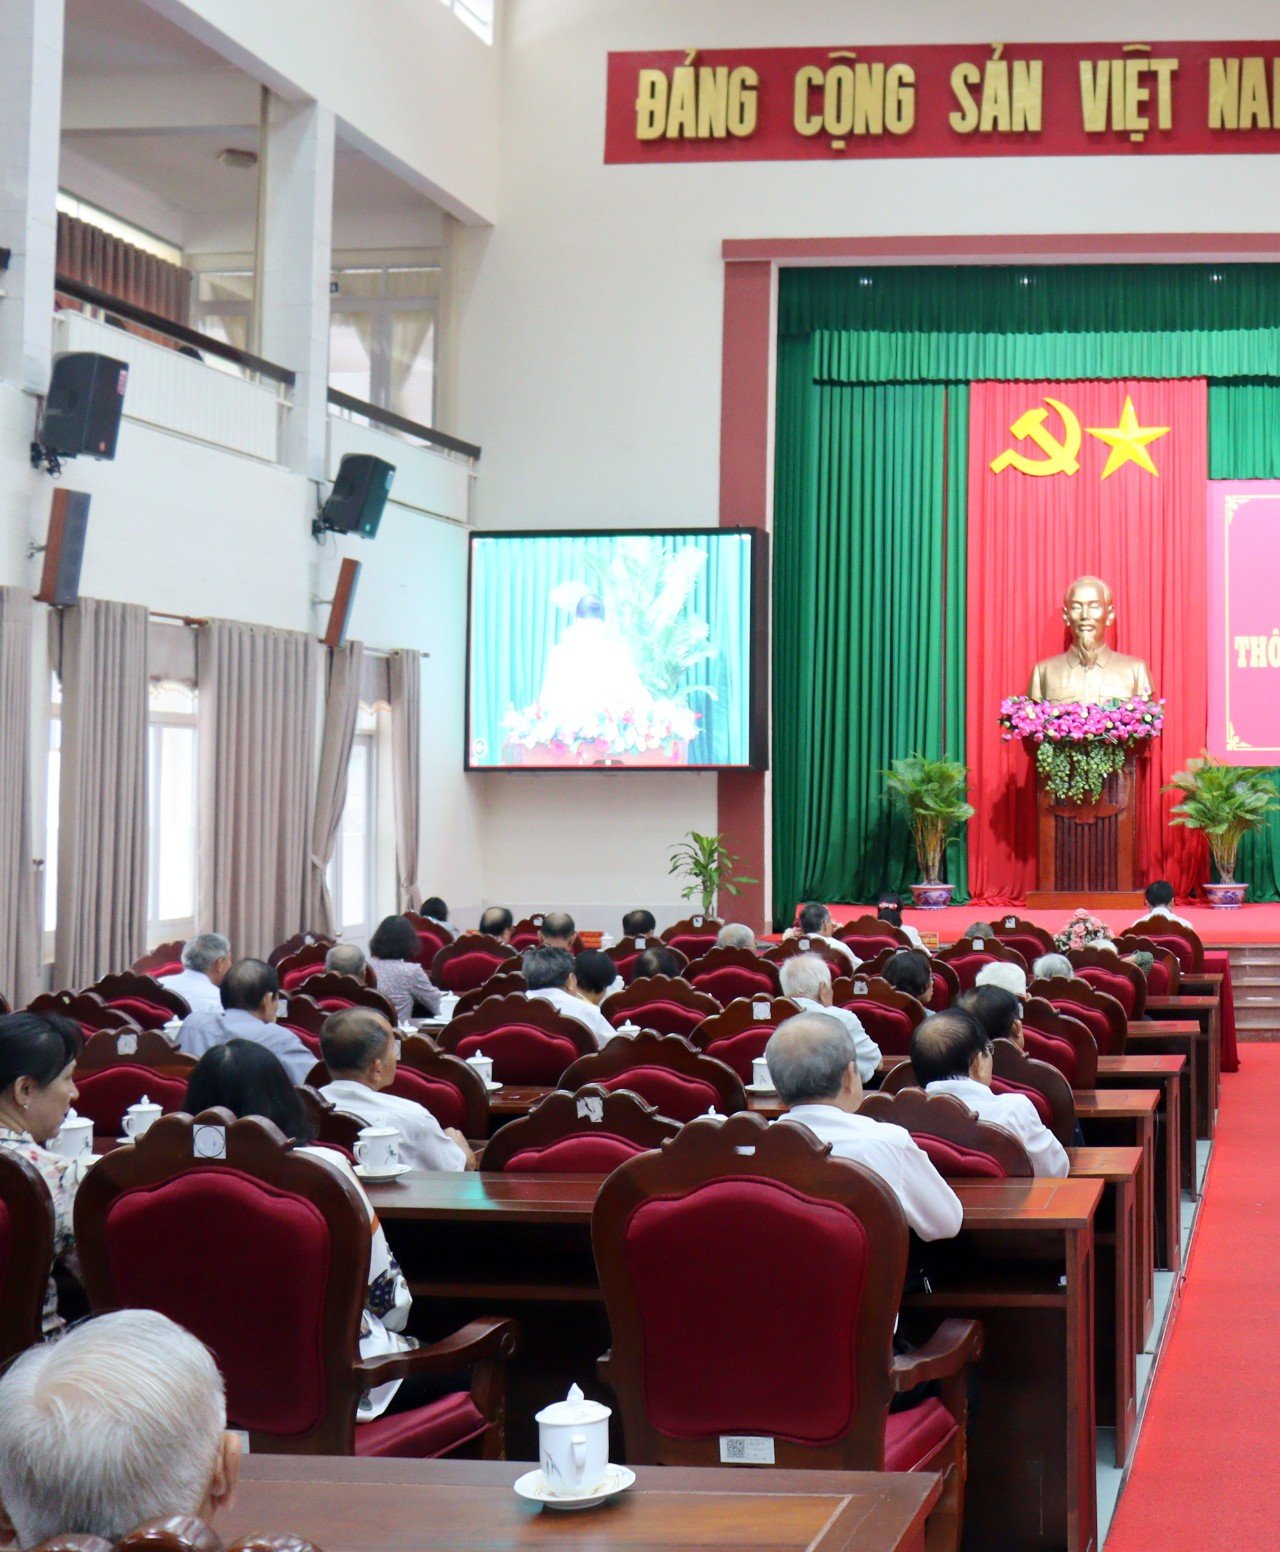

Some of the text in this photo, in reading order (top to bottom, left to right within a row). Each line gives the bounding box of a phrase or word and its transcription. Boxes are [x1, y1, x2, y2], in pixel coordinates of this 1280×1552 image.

[635, 49, 759, 140] ĐẢNG
[794, 50, 916, 150] CỘNG
[949, 42, 1042, 133] SẢN
[1079, 44, 1179, 142] VIỆT
